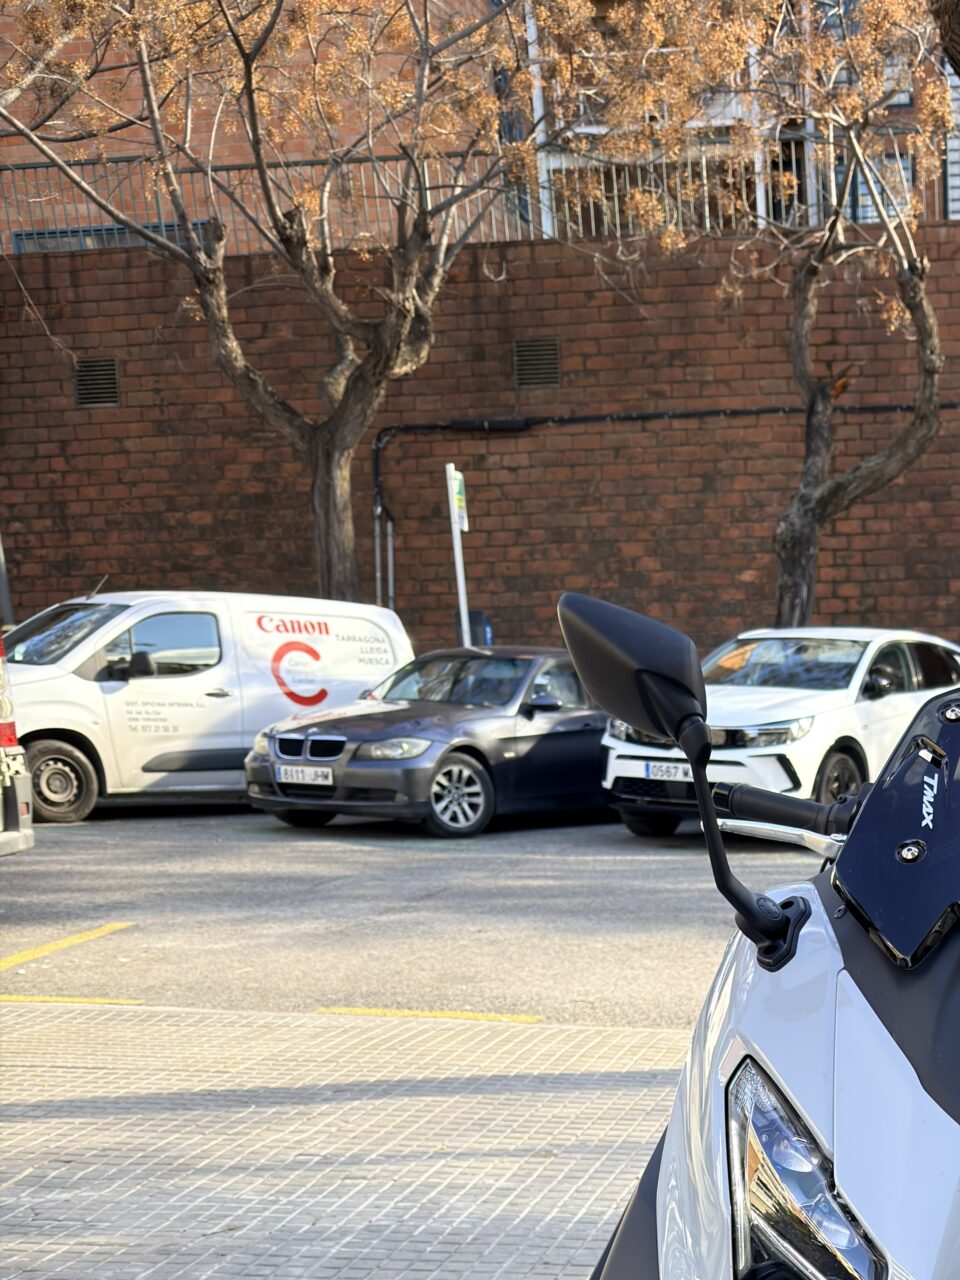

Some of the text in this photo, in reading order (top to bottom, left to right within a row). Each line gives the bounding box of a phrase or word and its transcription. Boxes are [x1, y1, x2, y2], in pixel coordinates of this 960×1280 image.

[256, 615, 330, 636] Canon
[335, 634, 387, 645] TARRAGONA
[921, 773, 939, 829] TMAX
